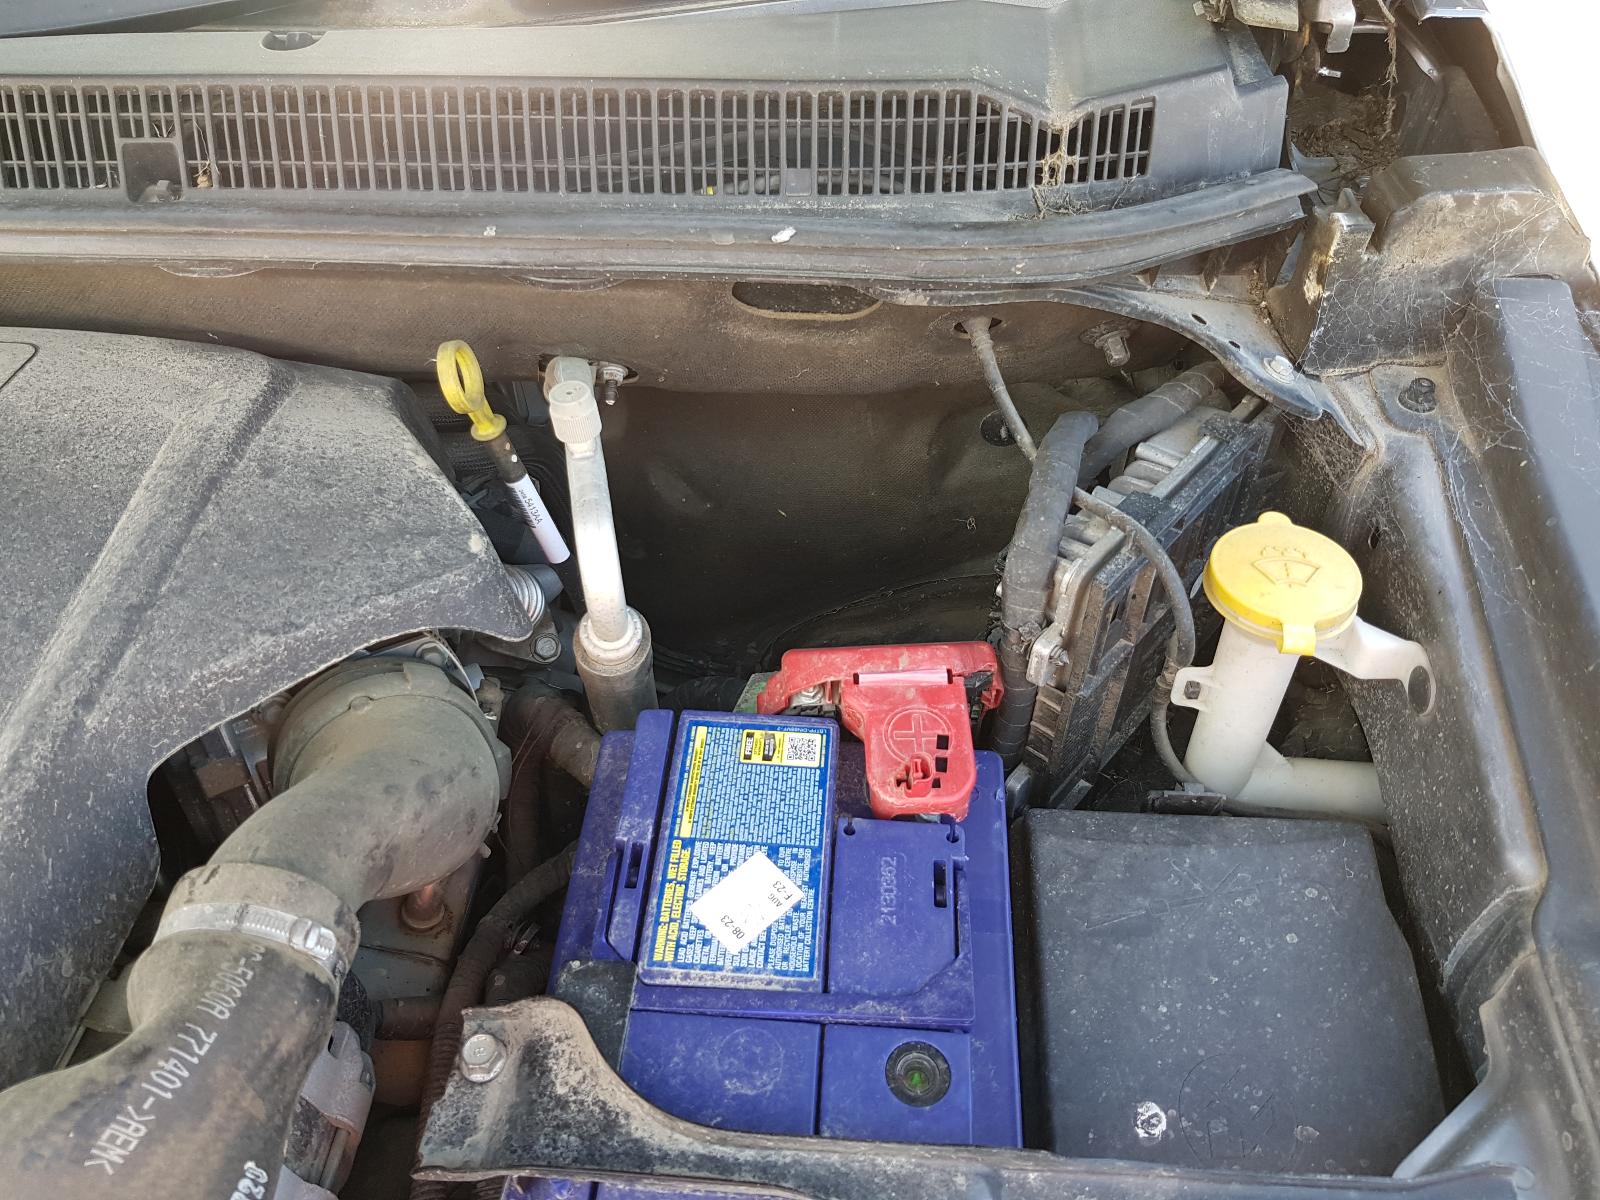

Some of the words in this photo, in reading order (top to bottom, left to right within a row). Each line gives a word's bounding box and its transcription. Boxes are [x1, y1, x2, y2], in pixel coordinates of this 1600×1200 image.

[745, 736, 754, 755] FREE
[670, 840, 682, 862] FILLED
[667, 864, 678, 879] WET
[671, 884, 685, 918] ELECTRIC
[768, 893, 783, 907] AUG
[773, 881, 793, 900] F-23
[660, 881, 677, 922] BATTERIES,
[689, 926, 697, 940] KEEP
[698, 865, 706, 876] AND
[701, 945, 710, 964] METAL
[715, 843, 724, 865] BATTERY
[668, 920, 682, 940] ACID,
[721, 915, 745, 939] 08-23
[799, 931, 804, 939] OF
[805, 911, 813, 944] COLLECTION
[653, 923, 668, 961] WARNING:
[680, 932, 689, 945] ACID
[664, 941, 676, 961] WITH
[677, 948, 686, 962] LEAD
[748, 947, 757, 967] LARGE
[757, 943, 765, 968] CONTACT
[768, 948, 776, 969] PLEASE
[775, 934, 784, 969] AUTHORISED
[789, 936, 797, 970] HOUSEHOLD
[783, 962, 788, 970] OR
